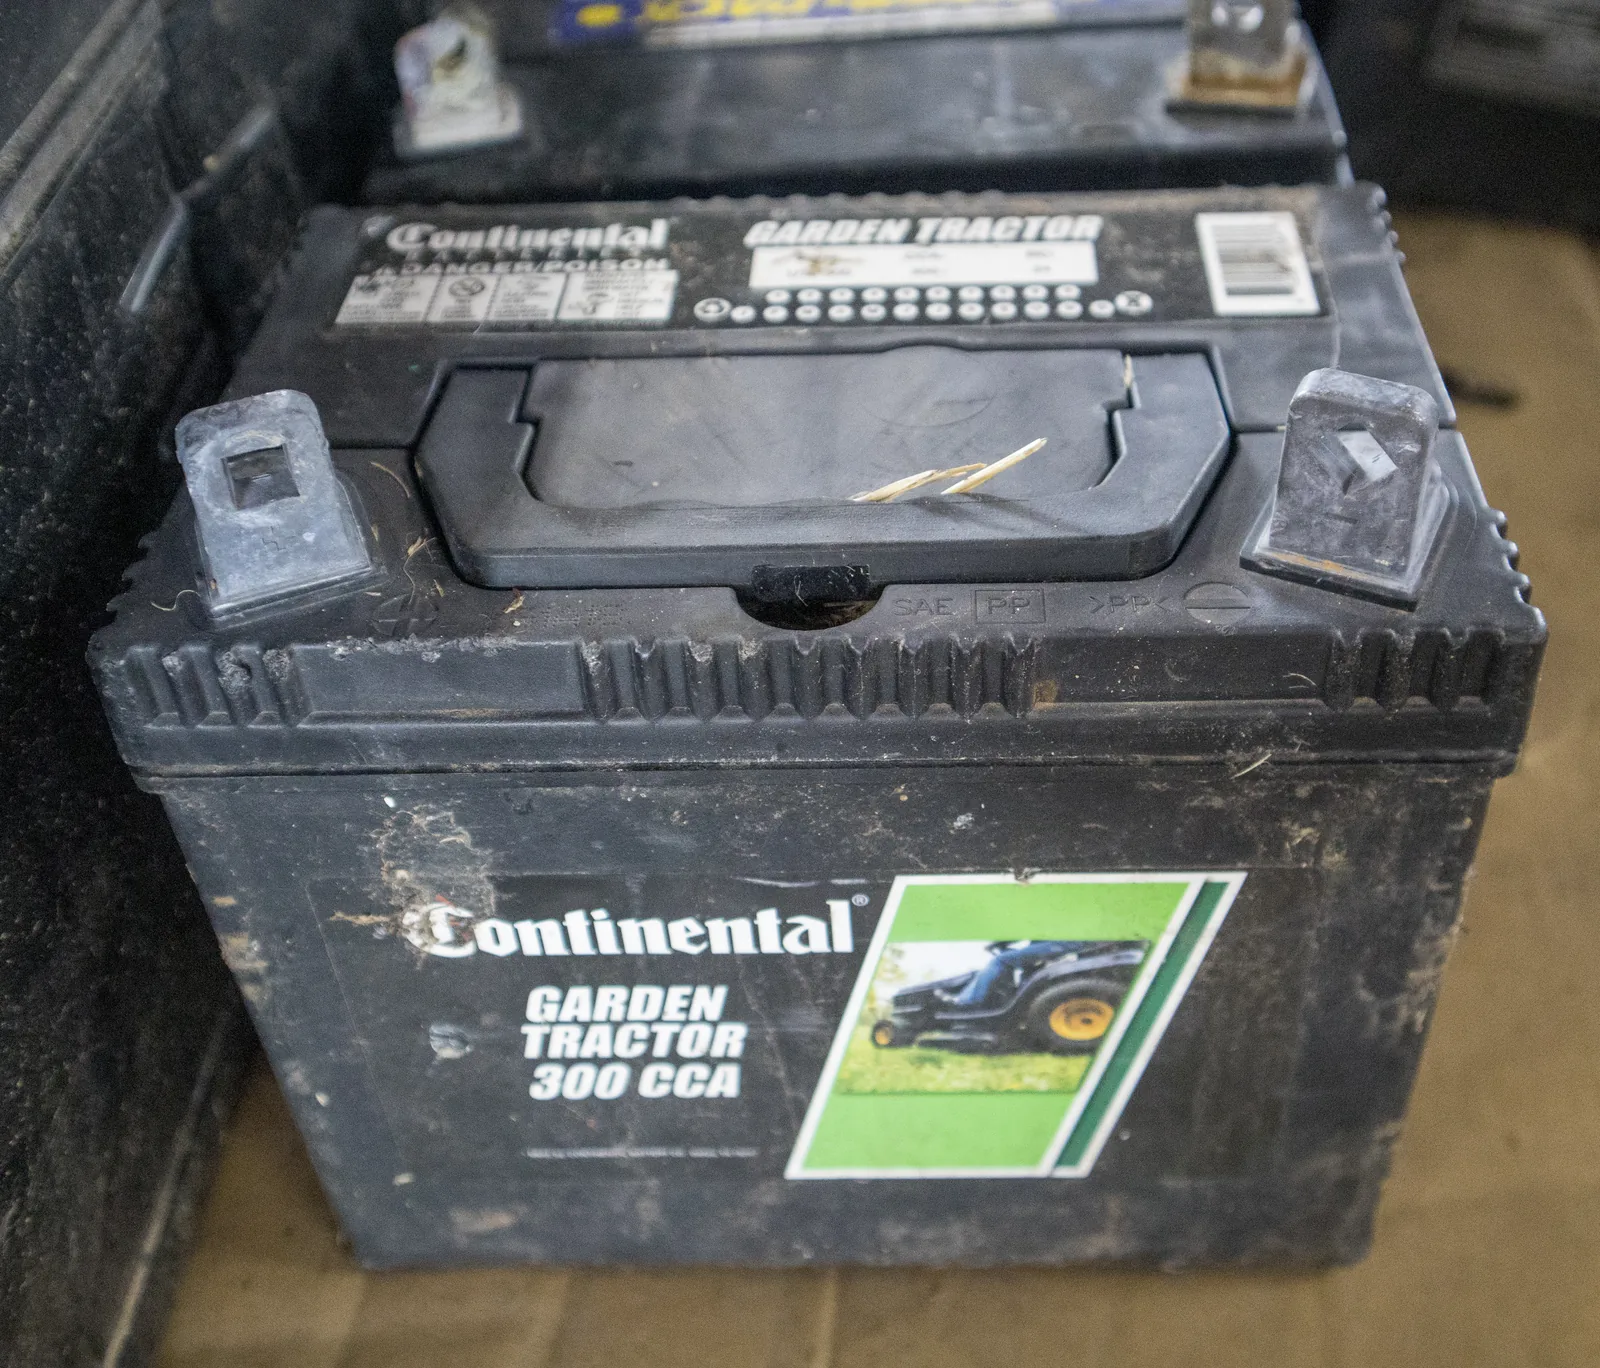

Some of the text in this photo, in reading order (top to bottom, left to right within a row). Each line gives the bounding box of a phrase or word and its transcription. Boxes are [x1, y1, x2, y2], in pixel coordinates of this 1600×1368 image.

[387, 218, 668, 251] Continental
[743, 215, 1103, 247] GARDEN TRACTOR
[895, 598, 953, 616] SAE
[988, 596, 1031, 615] PP
[525, 985, 729, 1022] GARDEN
[520, 1022, 749, 1060] TRACTOR
[529, 1063, 742, 1100] 300 CCA
